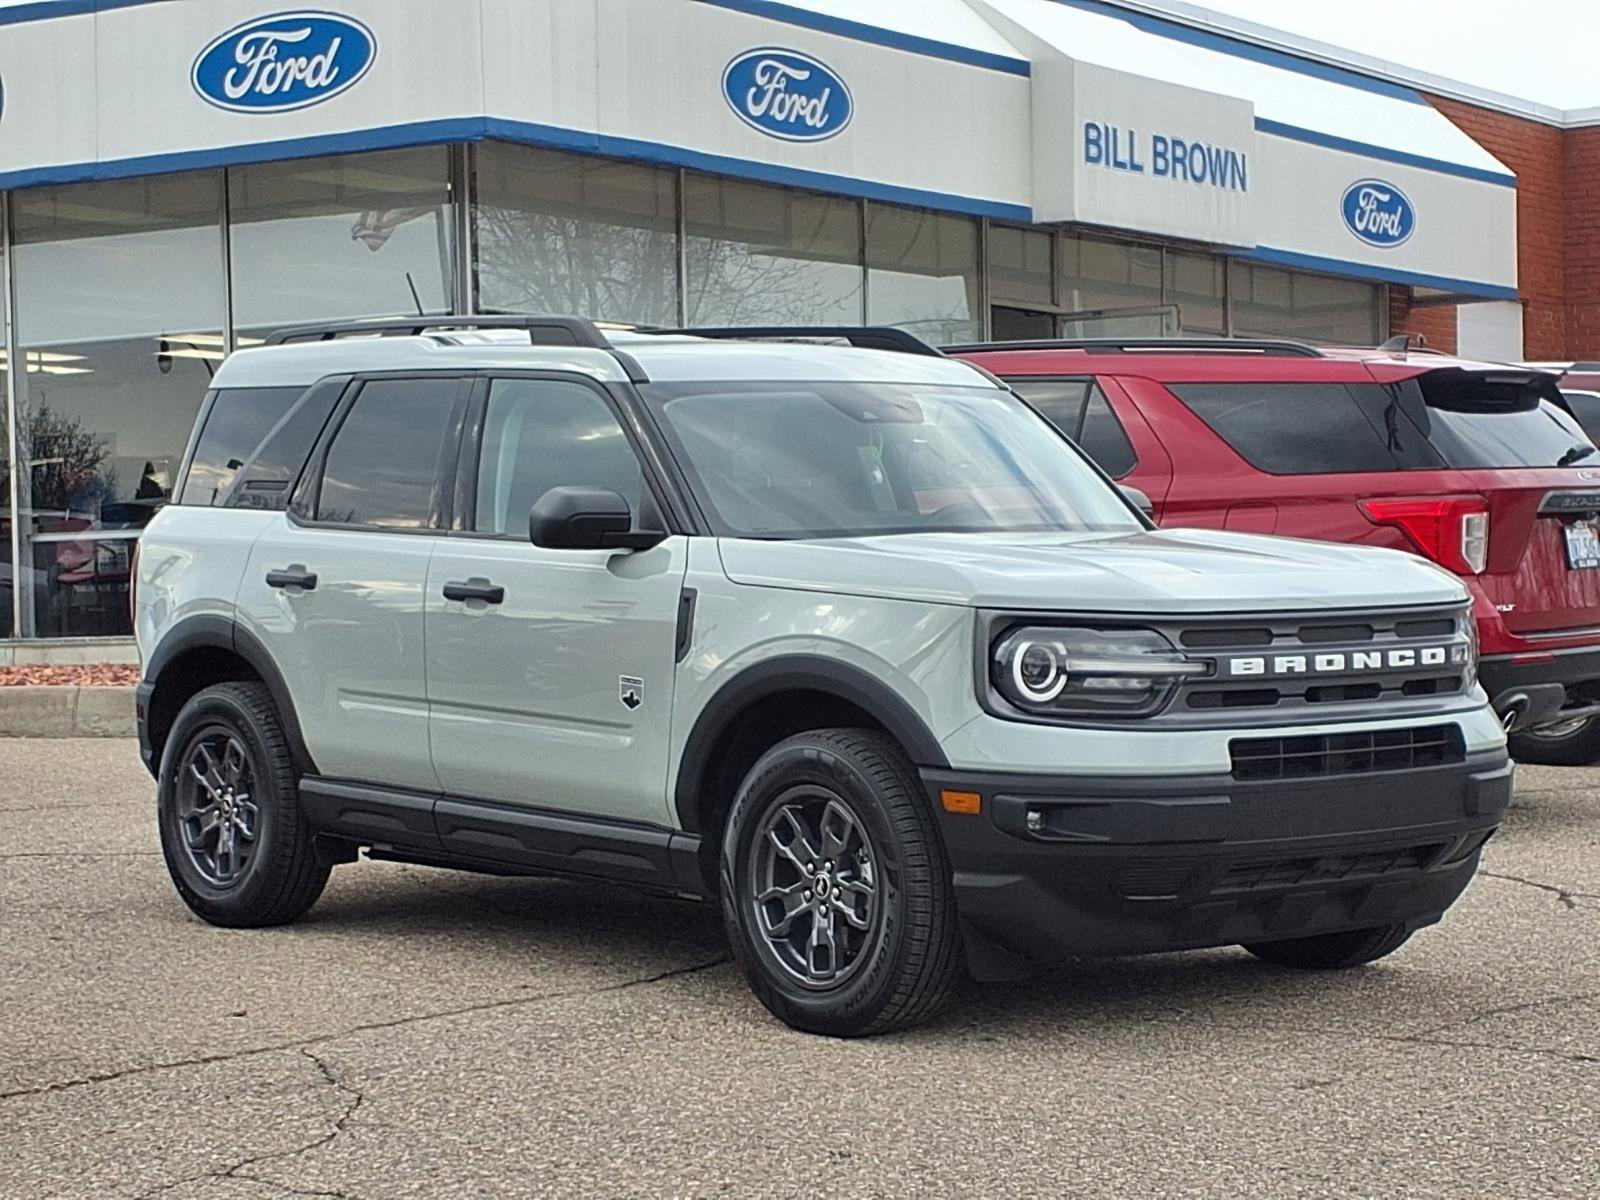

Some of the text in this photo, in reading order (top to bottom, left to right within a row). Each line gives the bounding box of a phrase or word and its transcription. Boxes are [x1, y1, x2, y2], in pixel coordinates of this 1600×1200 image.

[224, 27, 342, 99] Ford
[746, 59, 831, 129] Ford
[1085, 121, 1248, 192] BILL BROWN
[1355, 187, 1402, 237] Ford
[1230, 647, 1446, 676] BRONCO
